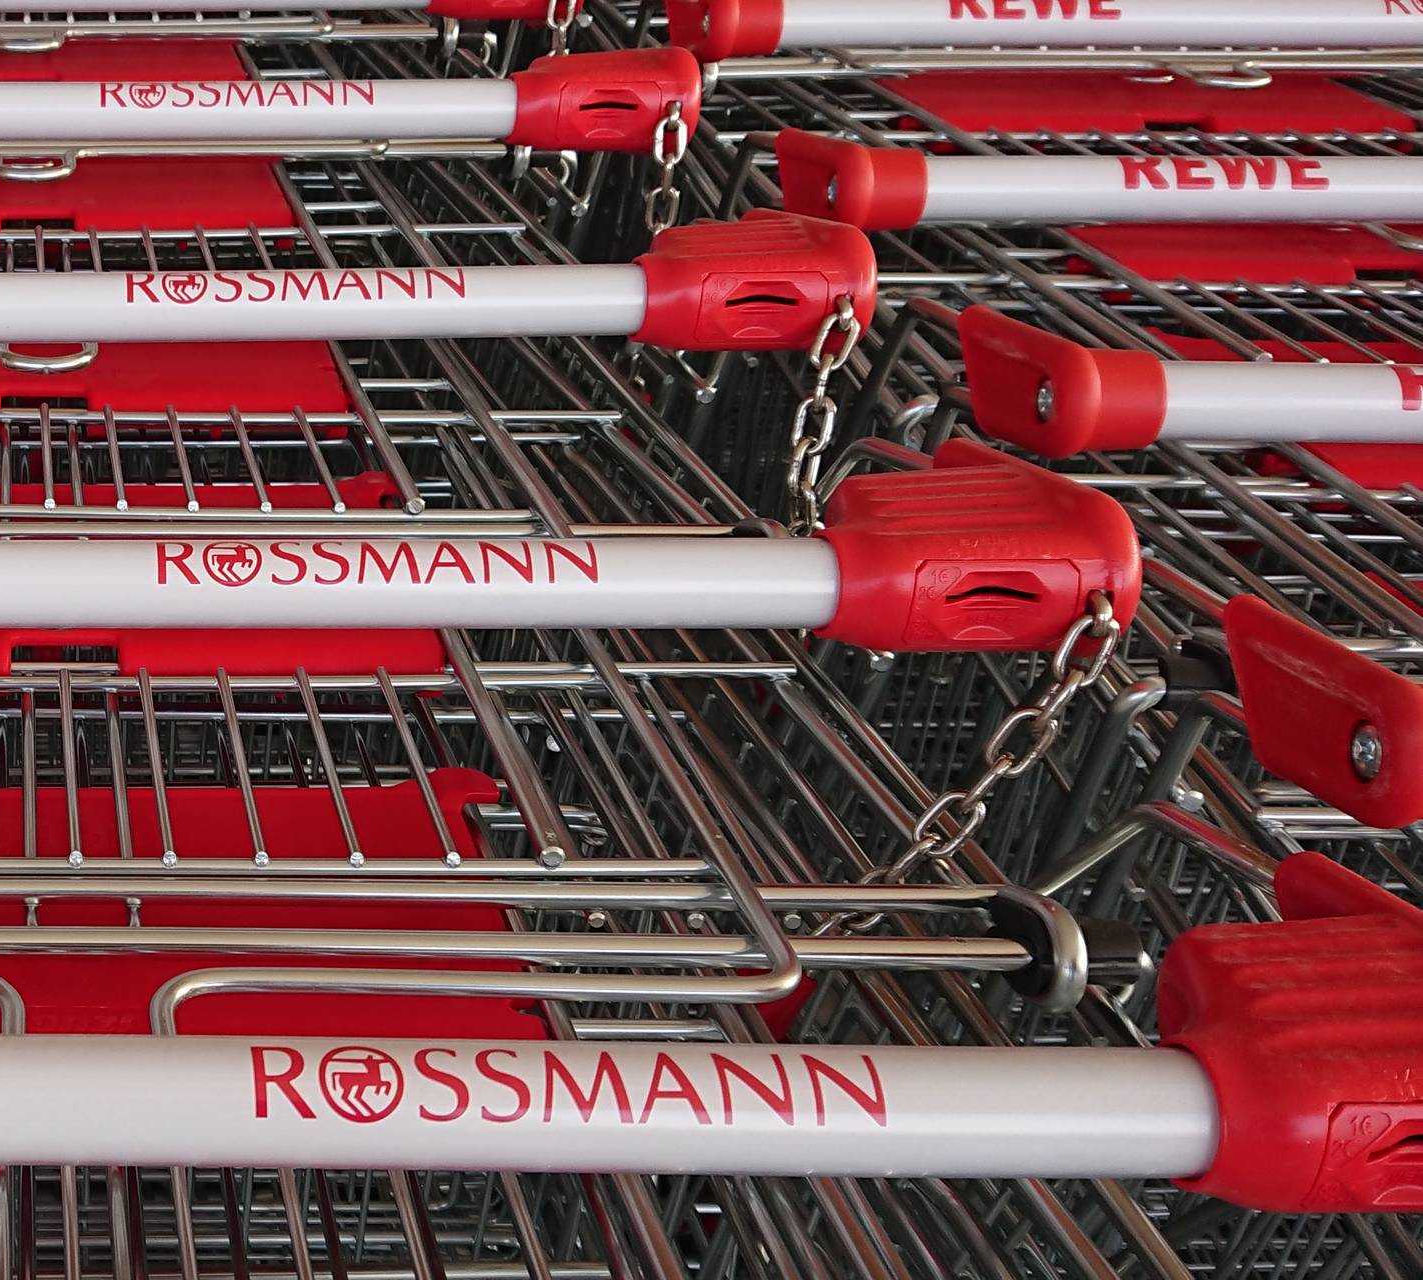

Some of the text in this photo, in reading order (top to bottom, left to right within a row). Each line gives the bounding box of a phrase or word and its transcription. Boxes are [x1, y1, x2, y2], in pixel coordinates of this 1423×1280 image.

[1119, 157, 1329, 190] REWE
[126, 270, 466, 305] ROSSMANN
[156, 542, 599, 588] ROSSMANN
[250, 1045, 888, 1126] ROSSMANN
